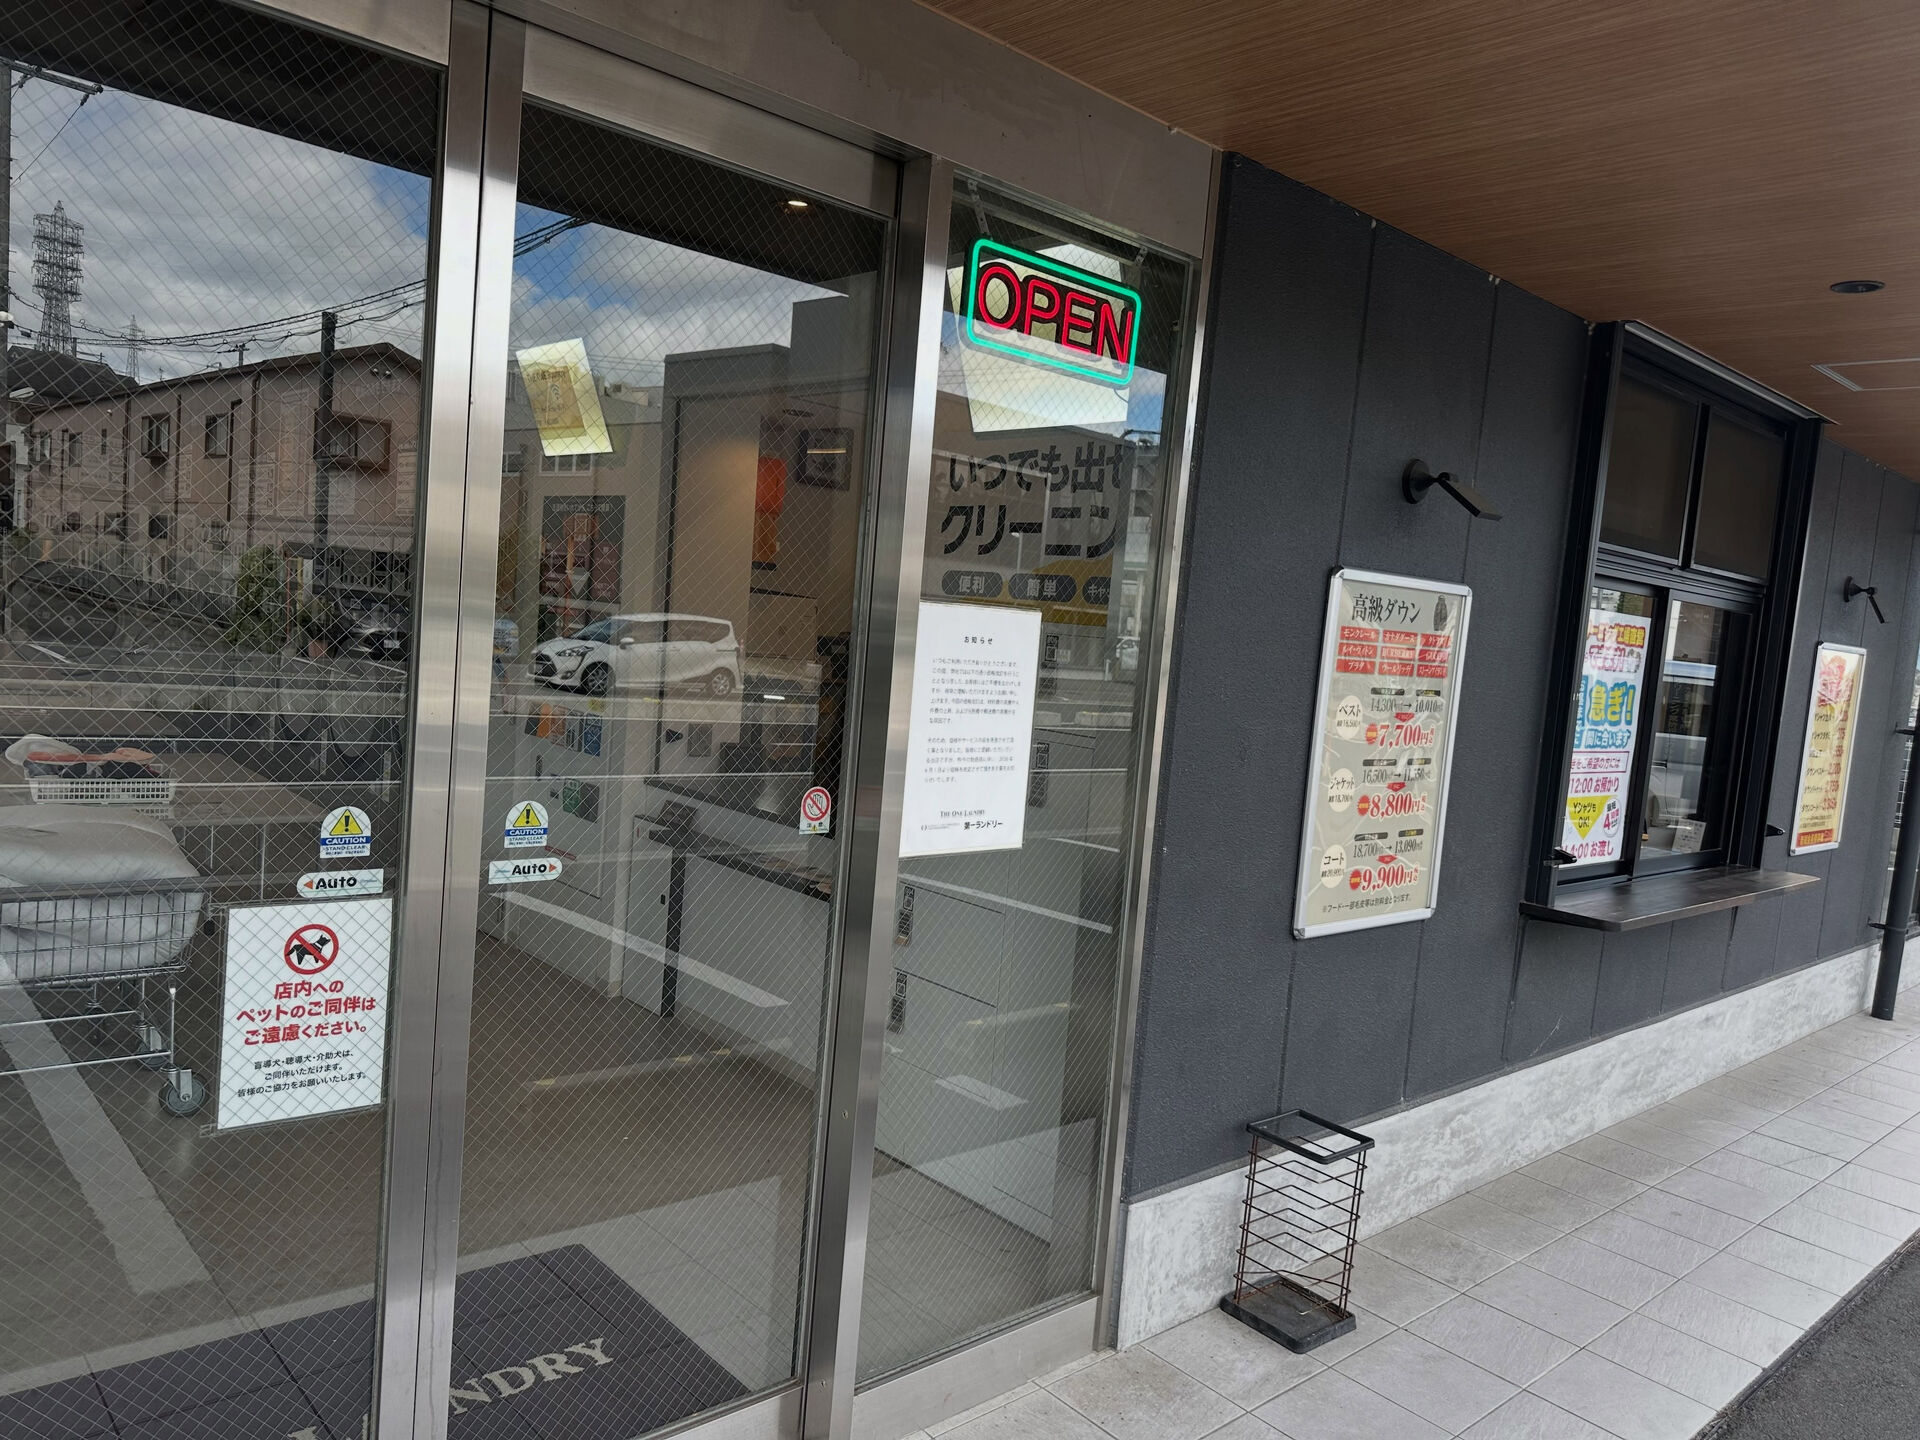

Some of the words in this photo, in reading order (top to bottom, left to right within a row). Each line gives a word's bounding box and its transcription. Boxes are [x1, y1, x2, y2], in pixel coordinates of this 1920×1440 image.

[978, 263, 1133, 366] OPEN
[958, 575, 985, 594] 便利
[1026, 577, 1058, 599] 簡単
[1351, 593, 1421, 624] 高級ダウン
[964, 636, 993, 645] お知らせ
[1339, 704, 1361, 717] ベスト
[326, 836, 367, 846] CAUTION
[509, 828, 544, 837] CAUTION
[1590, 840, 1614, 858] お渡し
[1323, 852, 1344, 866] コート
[511, 863, 547, 876] Auto
[315, 876, 358, 890] Auto
[273, 979, 344, 1001] 店内への
[236, 995, 377, 1023] ペットのご同伴は
[244, 1019, 367, 1046] ご遠慮ください。
[264, 1063, 343, 1081] ご同伴いただけます。
[237, 1071, 367, 1098] 皆様のご協力をお願いいたします。
